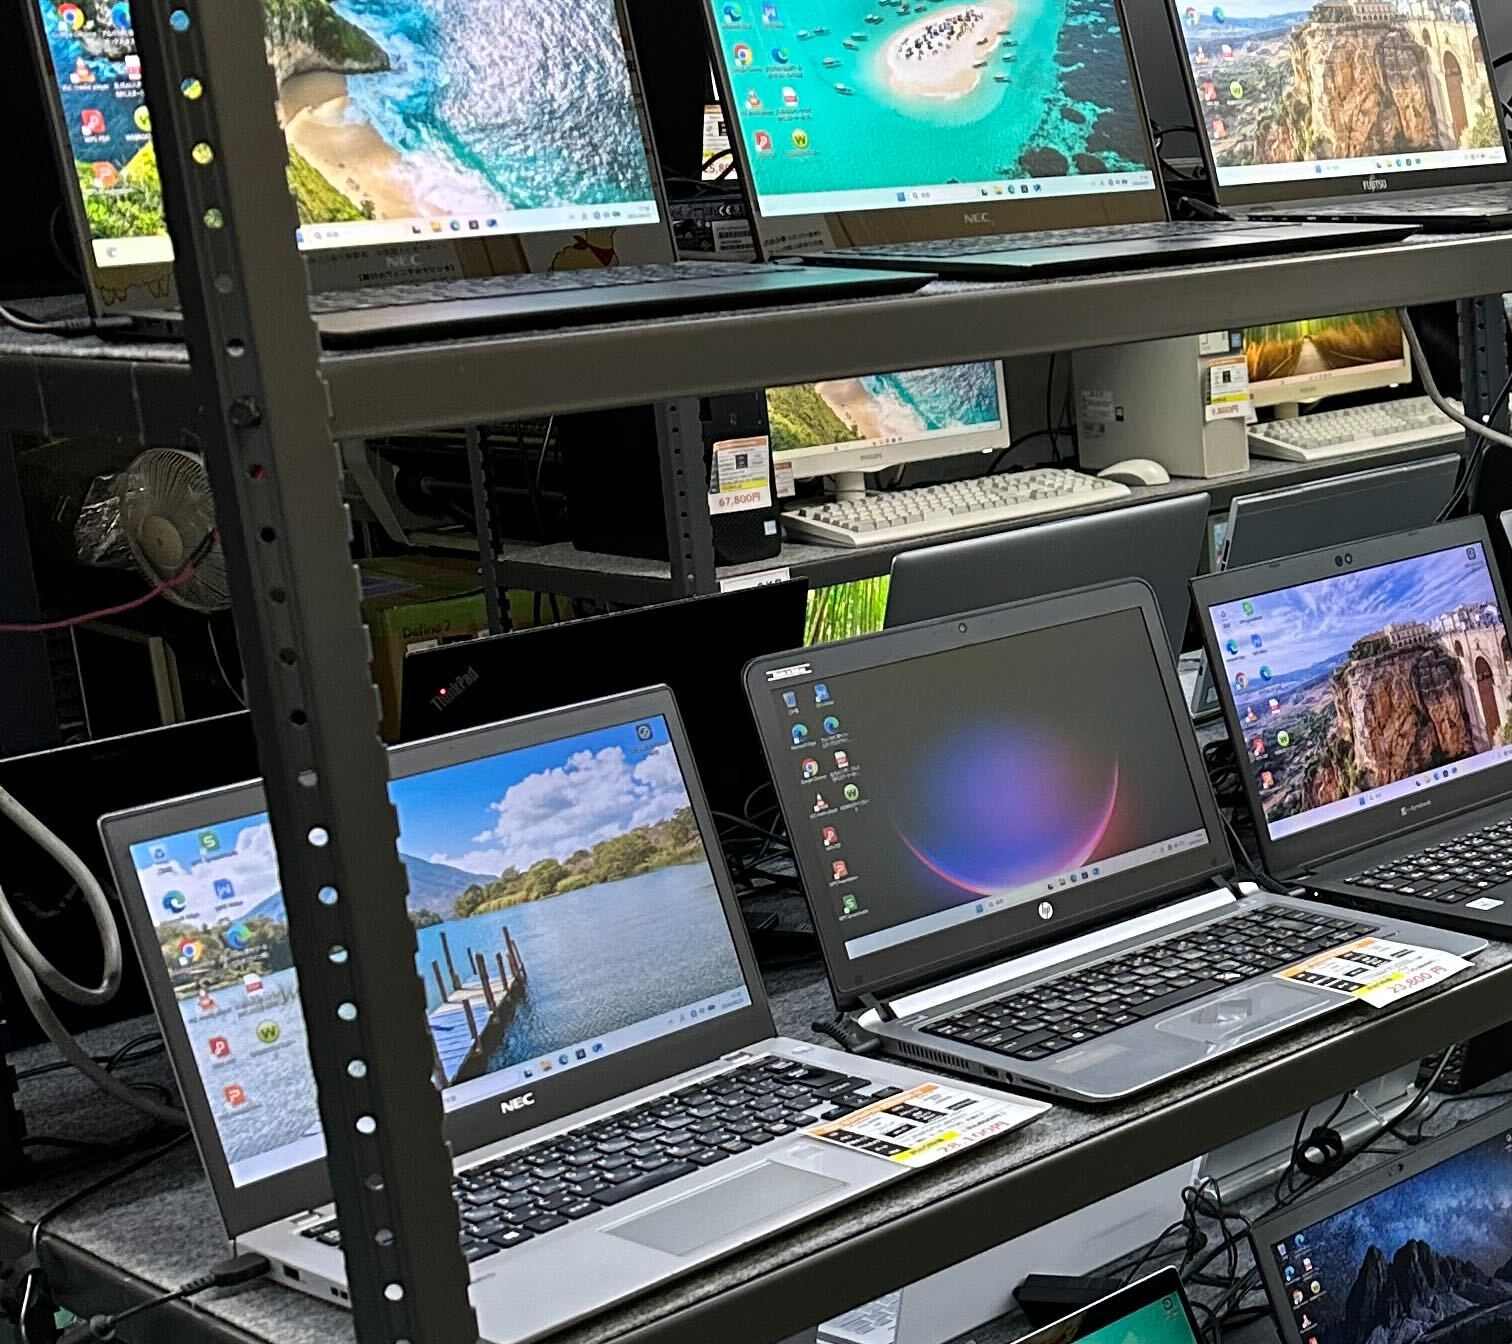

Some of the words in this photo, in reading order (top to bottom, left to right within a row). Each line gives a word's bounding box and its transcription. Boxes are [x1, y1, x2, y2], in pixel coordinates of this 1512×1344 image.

[1362, 175, 1388, 192] FUJITSU
[964, 211, 991, 225] NEC
[429, 665, 480, 712] ThinkPad
[500, 1091, 536, 1115] NEC
